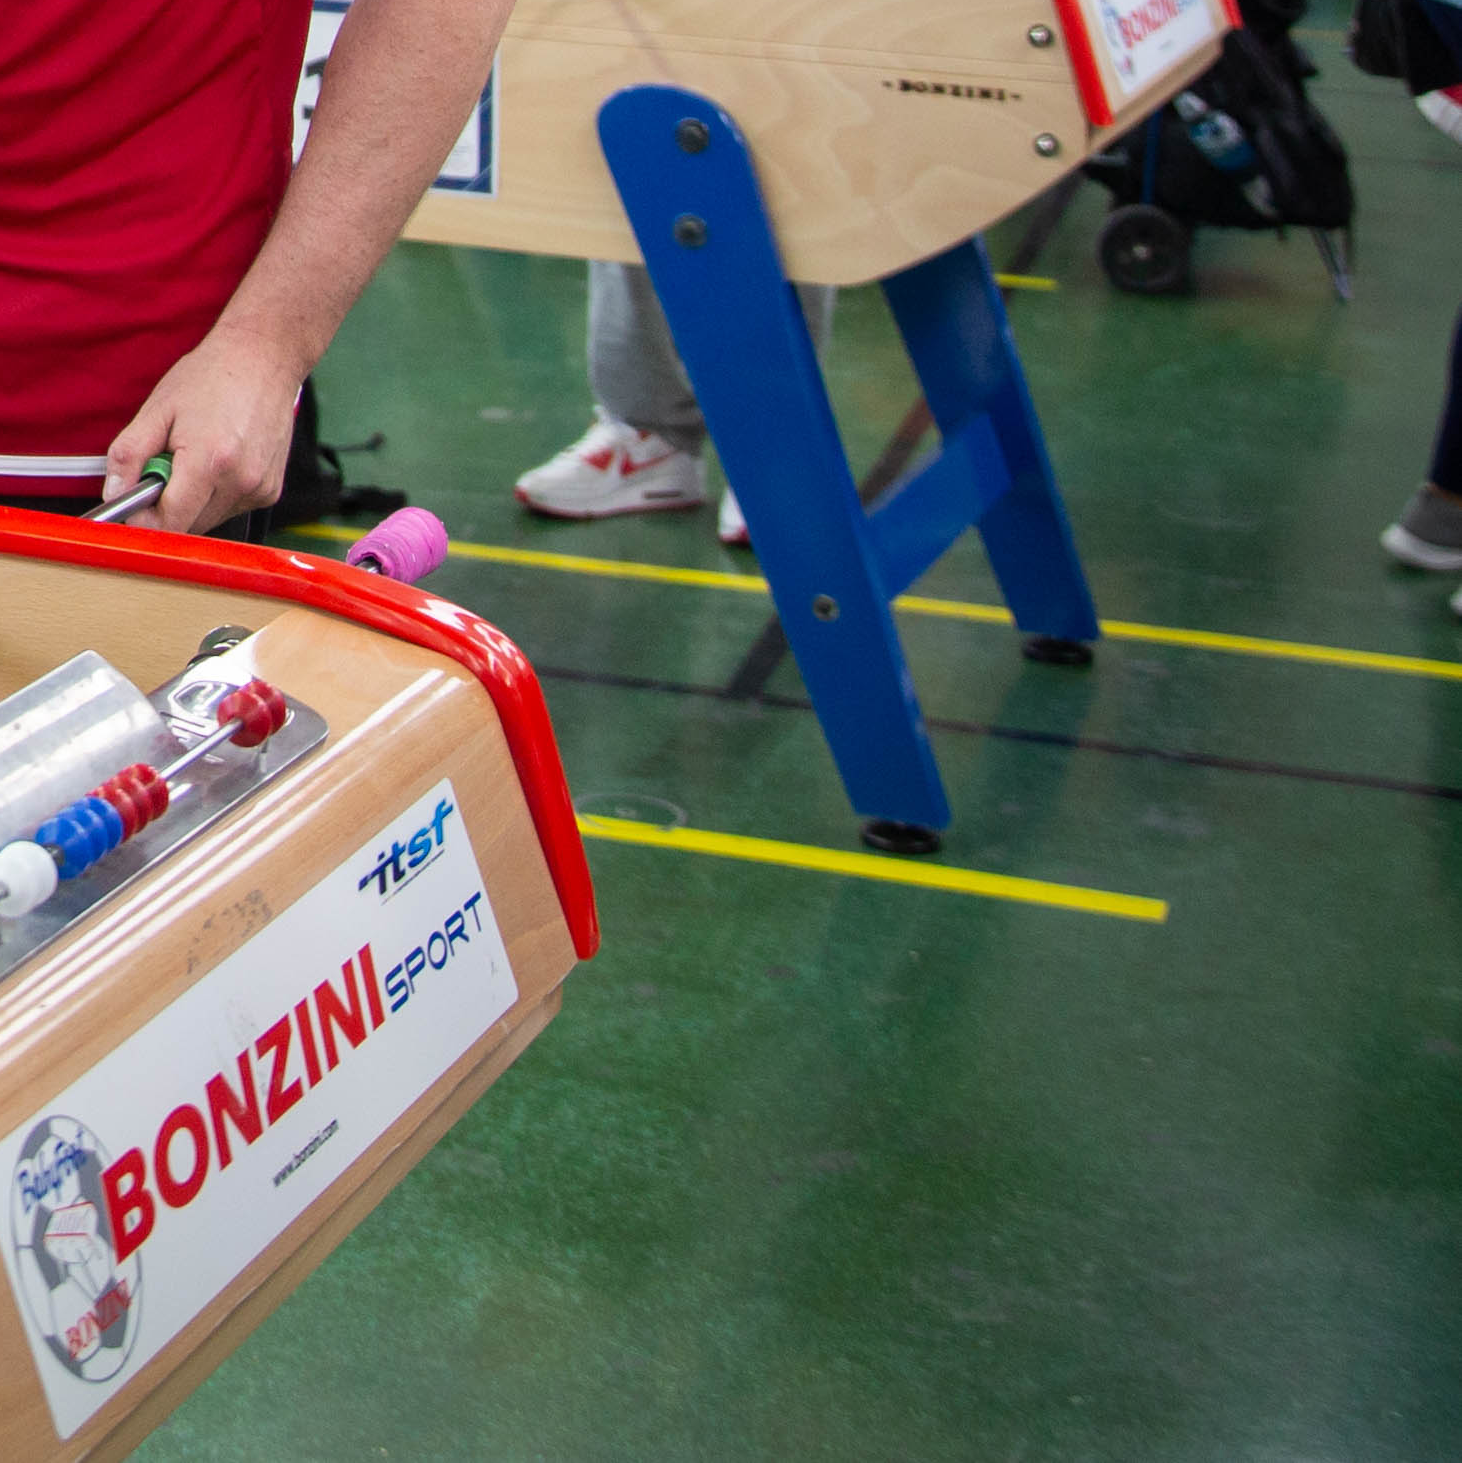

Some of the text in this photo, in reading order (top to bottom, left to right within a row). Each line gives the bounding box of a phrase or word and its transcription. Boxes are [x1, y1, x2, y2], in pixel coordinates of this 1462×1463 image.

[358, 796, 454, 896] itsf
[99, 890, 482, 1267] BONZINI SPORT
